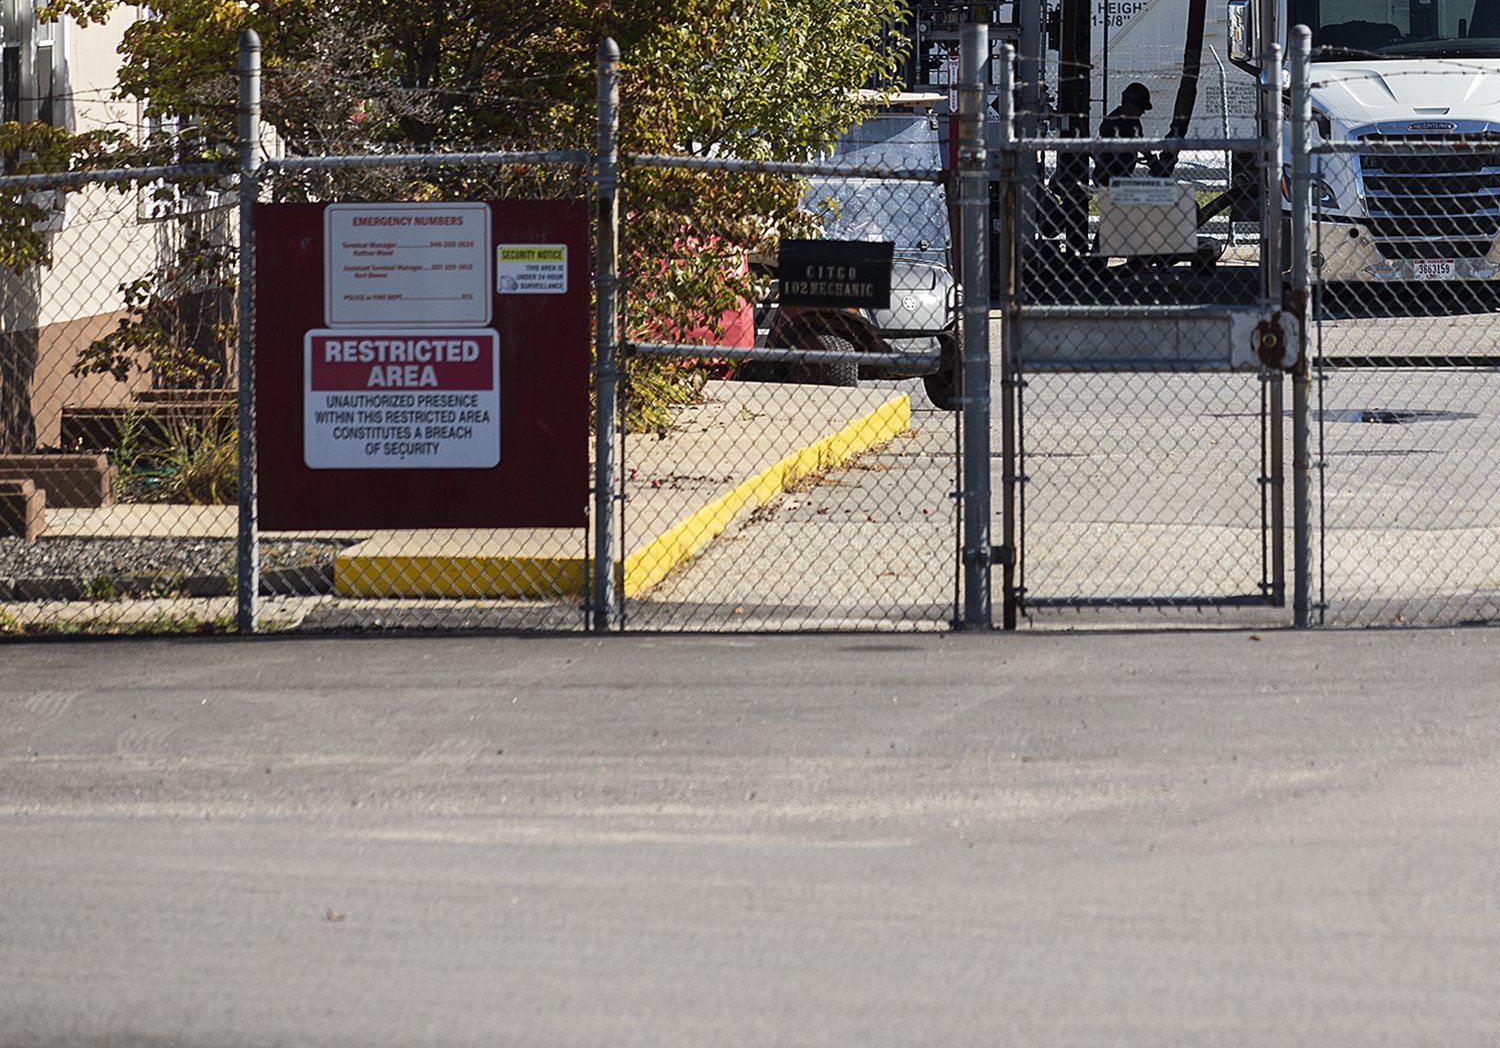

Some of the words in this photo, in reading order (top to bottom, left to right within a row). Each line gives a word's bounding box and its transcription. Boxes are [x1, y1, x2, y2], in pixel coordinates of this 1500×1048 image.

[352, 216, 412, 227] EMERGENCY
[414, 216, 464, 226] NUMBERS
[501, 250, 535, 260] SECURITY
[537, 250, 562, 260] NOTICE
[806, 265, 857, 281] CITGO
[810, 282, 874, 297] MECHANIC
[325, 340, 479, 363] RESTRICTED
[367, 365, 438, 387] AREA
[326, 395, 415, 408] UNAUTHORIZED
[418, 395, 478, 408] PRESENCE
[314, 410, 354, 424] WITHIN
[357, 410, 382, 424] THIS
[385, 410, 456, 424] RESTRICTED
[459, 410, 490, 424] AREA
[333, 426, 411, 440] CONSTITUTES
[414, 427, 422, 439] A
[425, 426, 472, 439] BREACH
[365, 442, 381, 455] OF
[384, 442, 440, 455] SECURITY
